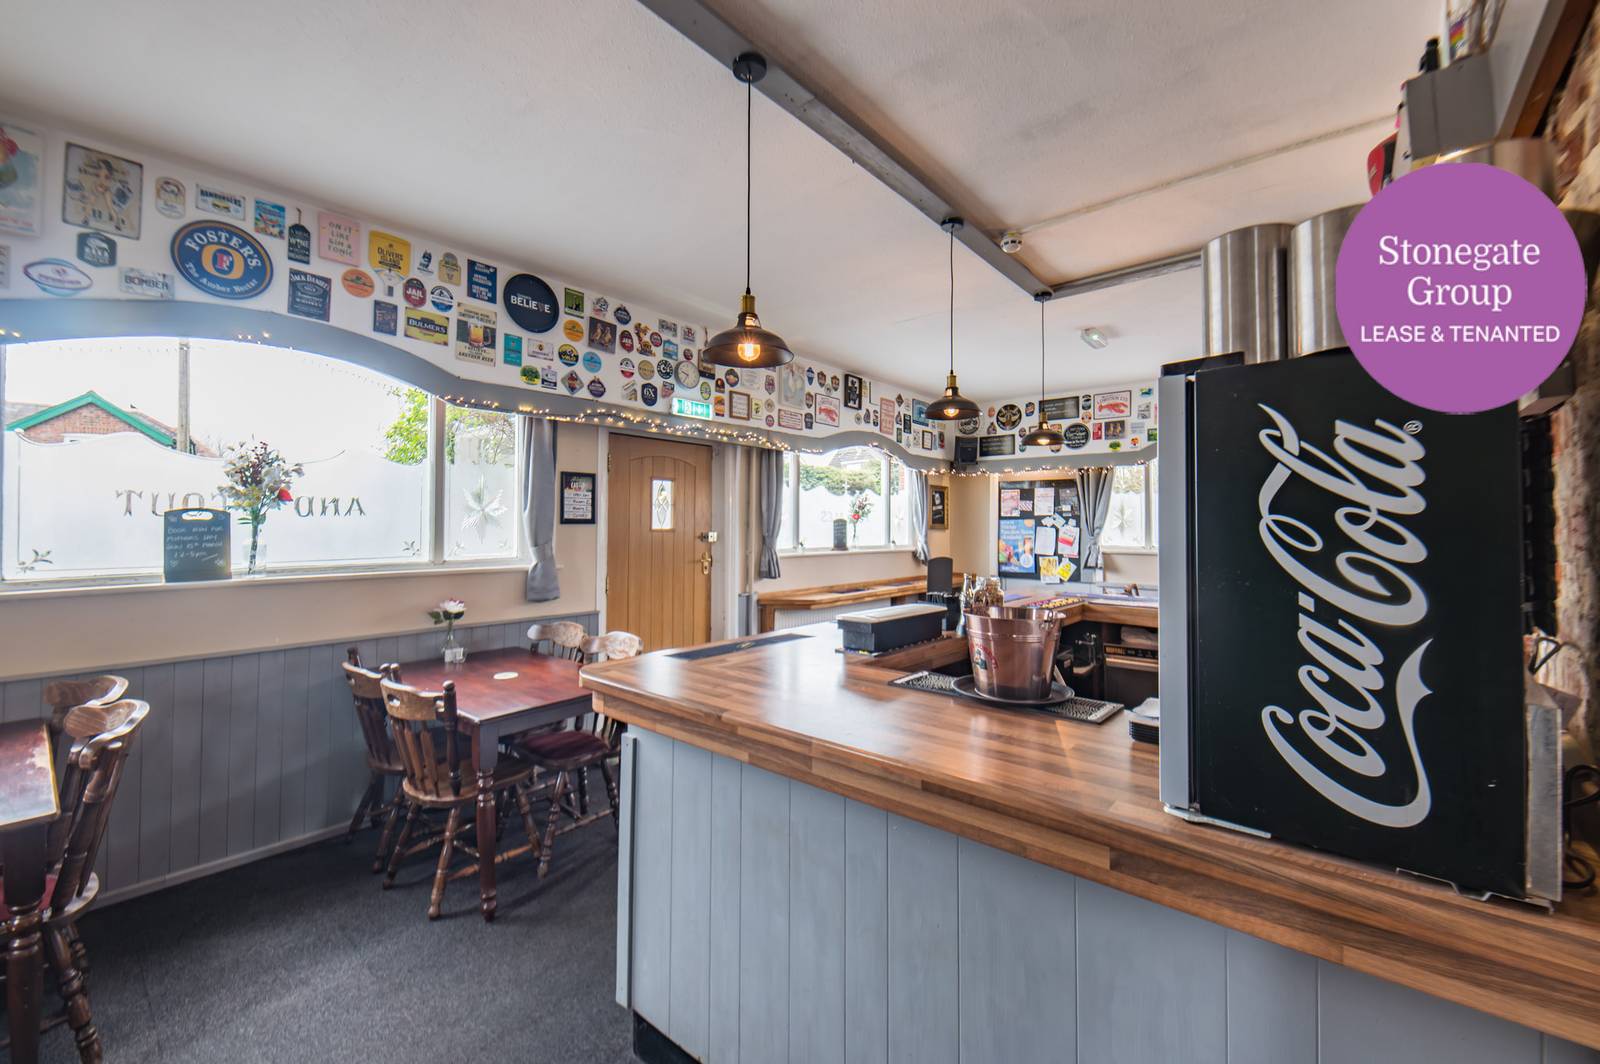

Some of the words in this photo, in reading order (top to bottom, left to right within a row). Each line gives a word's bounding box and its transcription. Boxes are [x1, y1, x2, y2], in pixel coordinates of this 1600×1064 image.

[185, 229, 262, 269] FOSTER'S
[406, 288, 423, 298] JAIL
[409, 318, 446, 333] BULMERS
